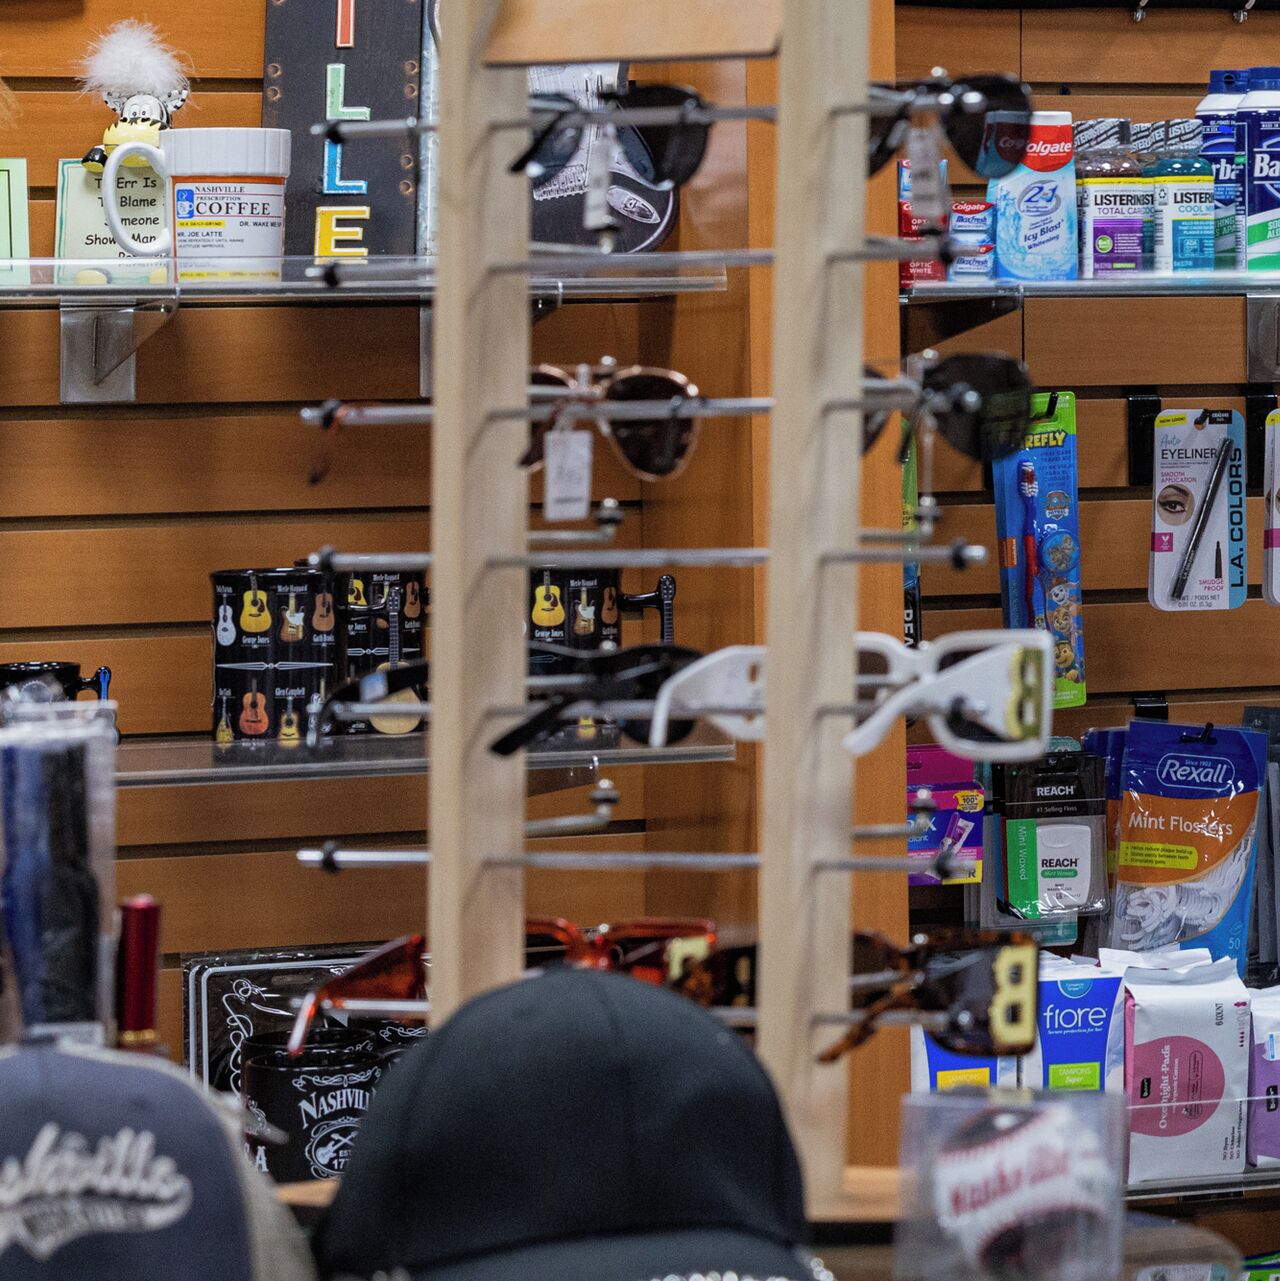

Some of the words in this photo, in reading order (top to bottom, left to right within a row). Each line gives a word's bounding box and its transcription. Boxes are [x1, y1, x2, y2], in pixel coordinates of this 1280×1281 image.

[196, 202, 270, 214] COFFEE
[1162, 449, 1217, 459] EYELINER
[1162, 760, 1226, 783] Rexall
[1037, 786, 1073, 796] REACH
[1041, 859, 1077, 868] REACH
[1043, 1005, 1106, 1031] fiore
